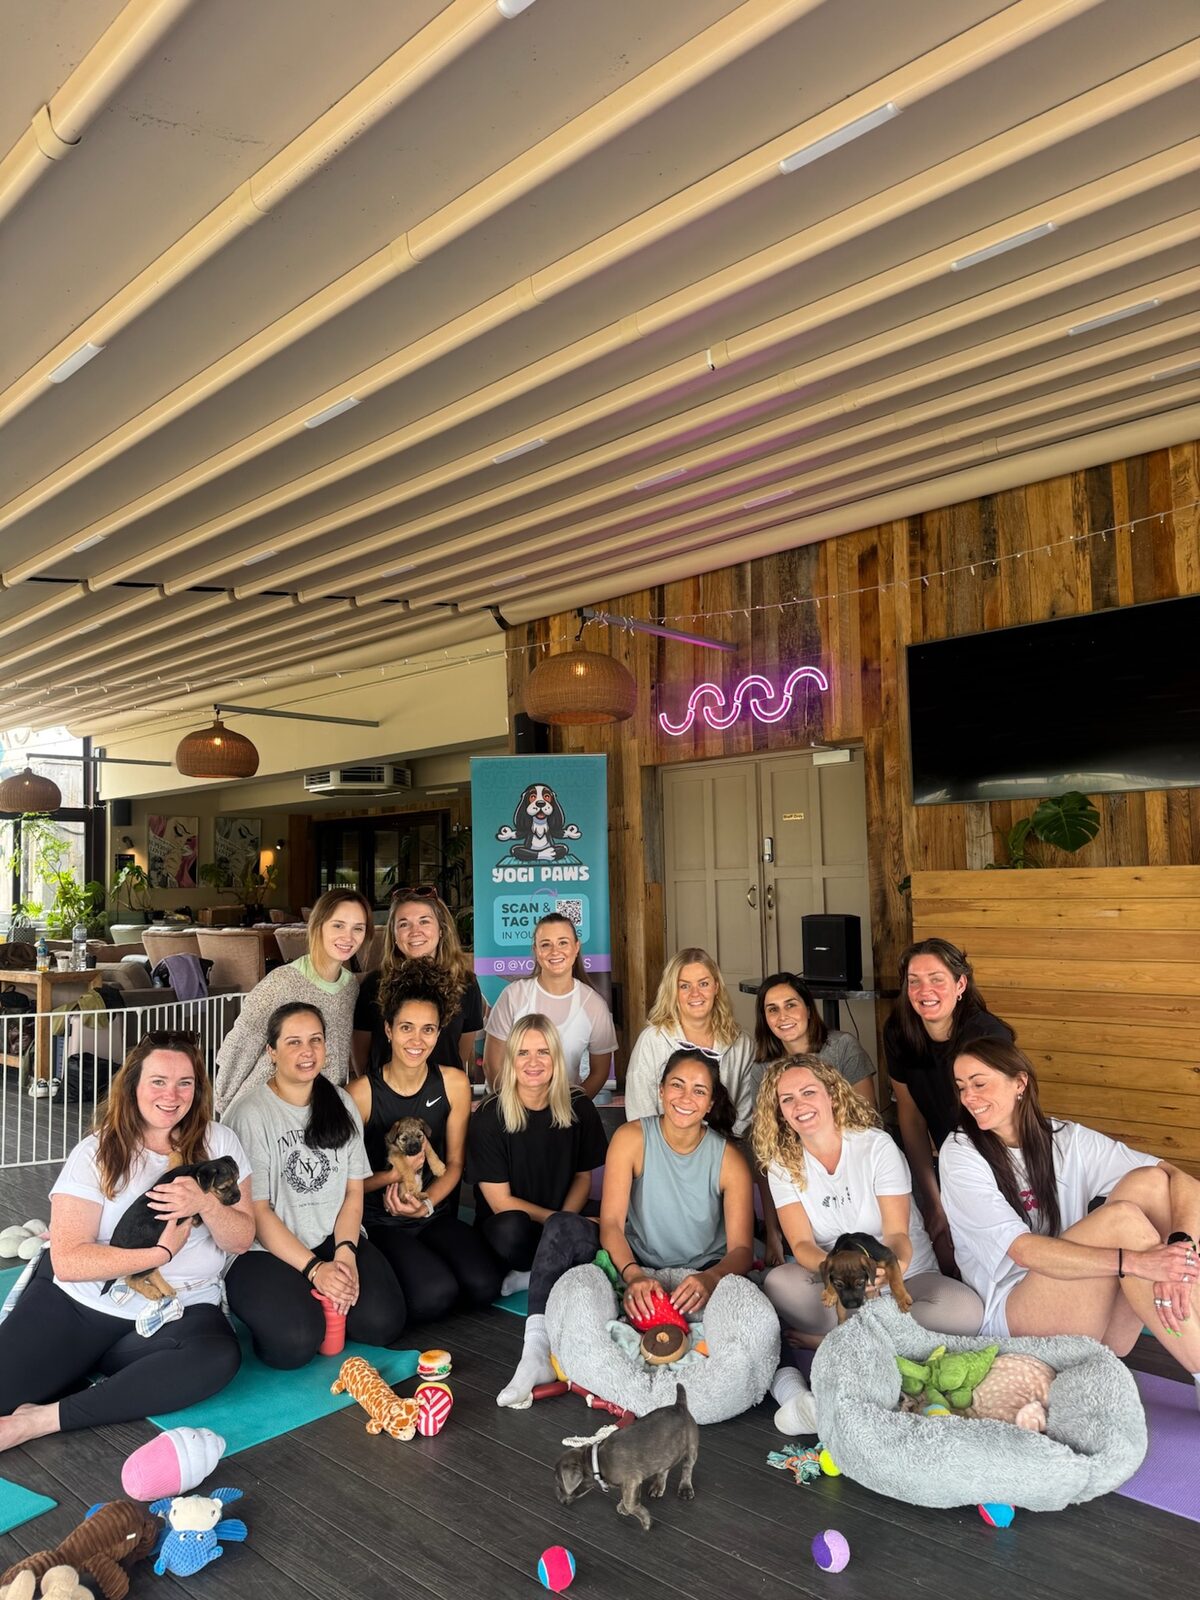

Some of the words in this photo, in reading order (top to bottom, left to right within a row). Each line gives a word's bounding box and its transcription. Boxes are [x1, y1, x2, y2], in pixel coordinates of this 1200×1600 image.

[492, 867, 534, 883] YOGI
[541, 866, 590, 882] PAWS
[501, 902, 539, 914] SCAN
[542, 902, 551, 913] &
[501, 916, 529, 927] TAG
[502, 931, 512, 940] IN
[514, 931, 534, 940] YOU
[299, 1158, 320, 1178] NY
